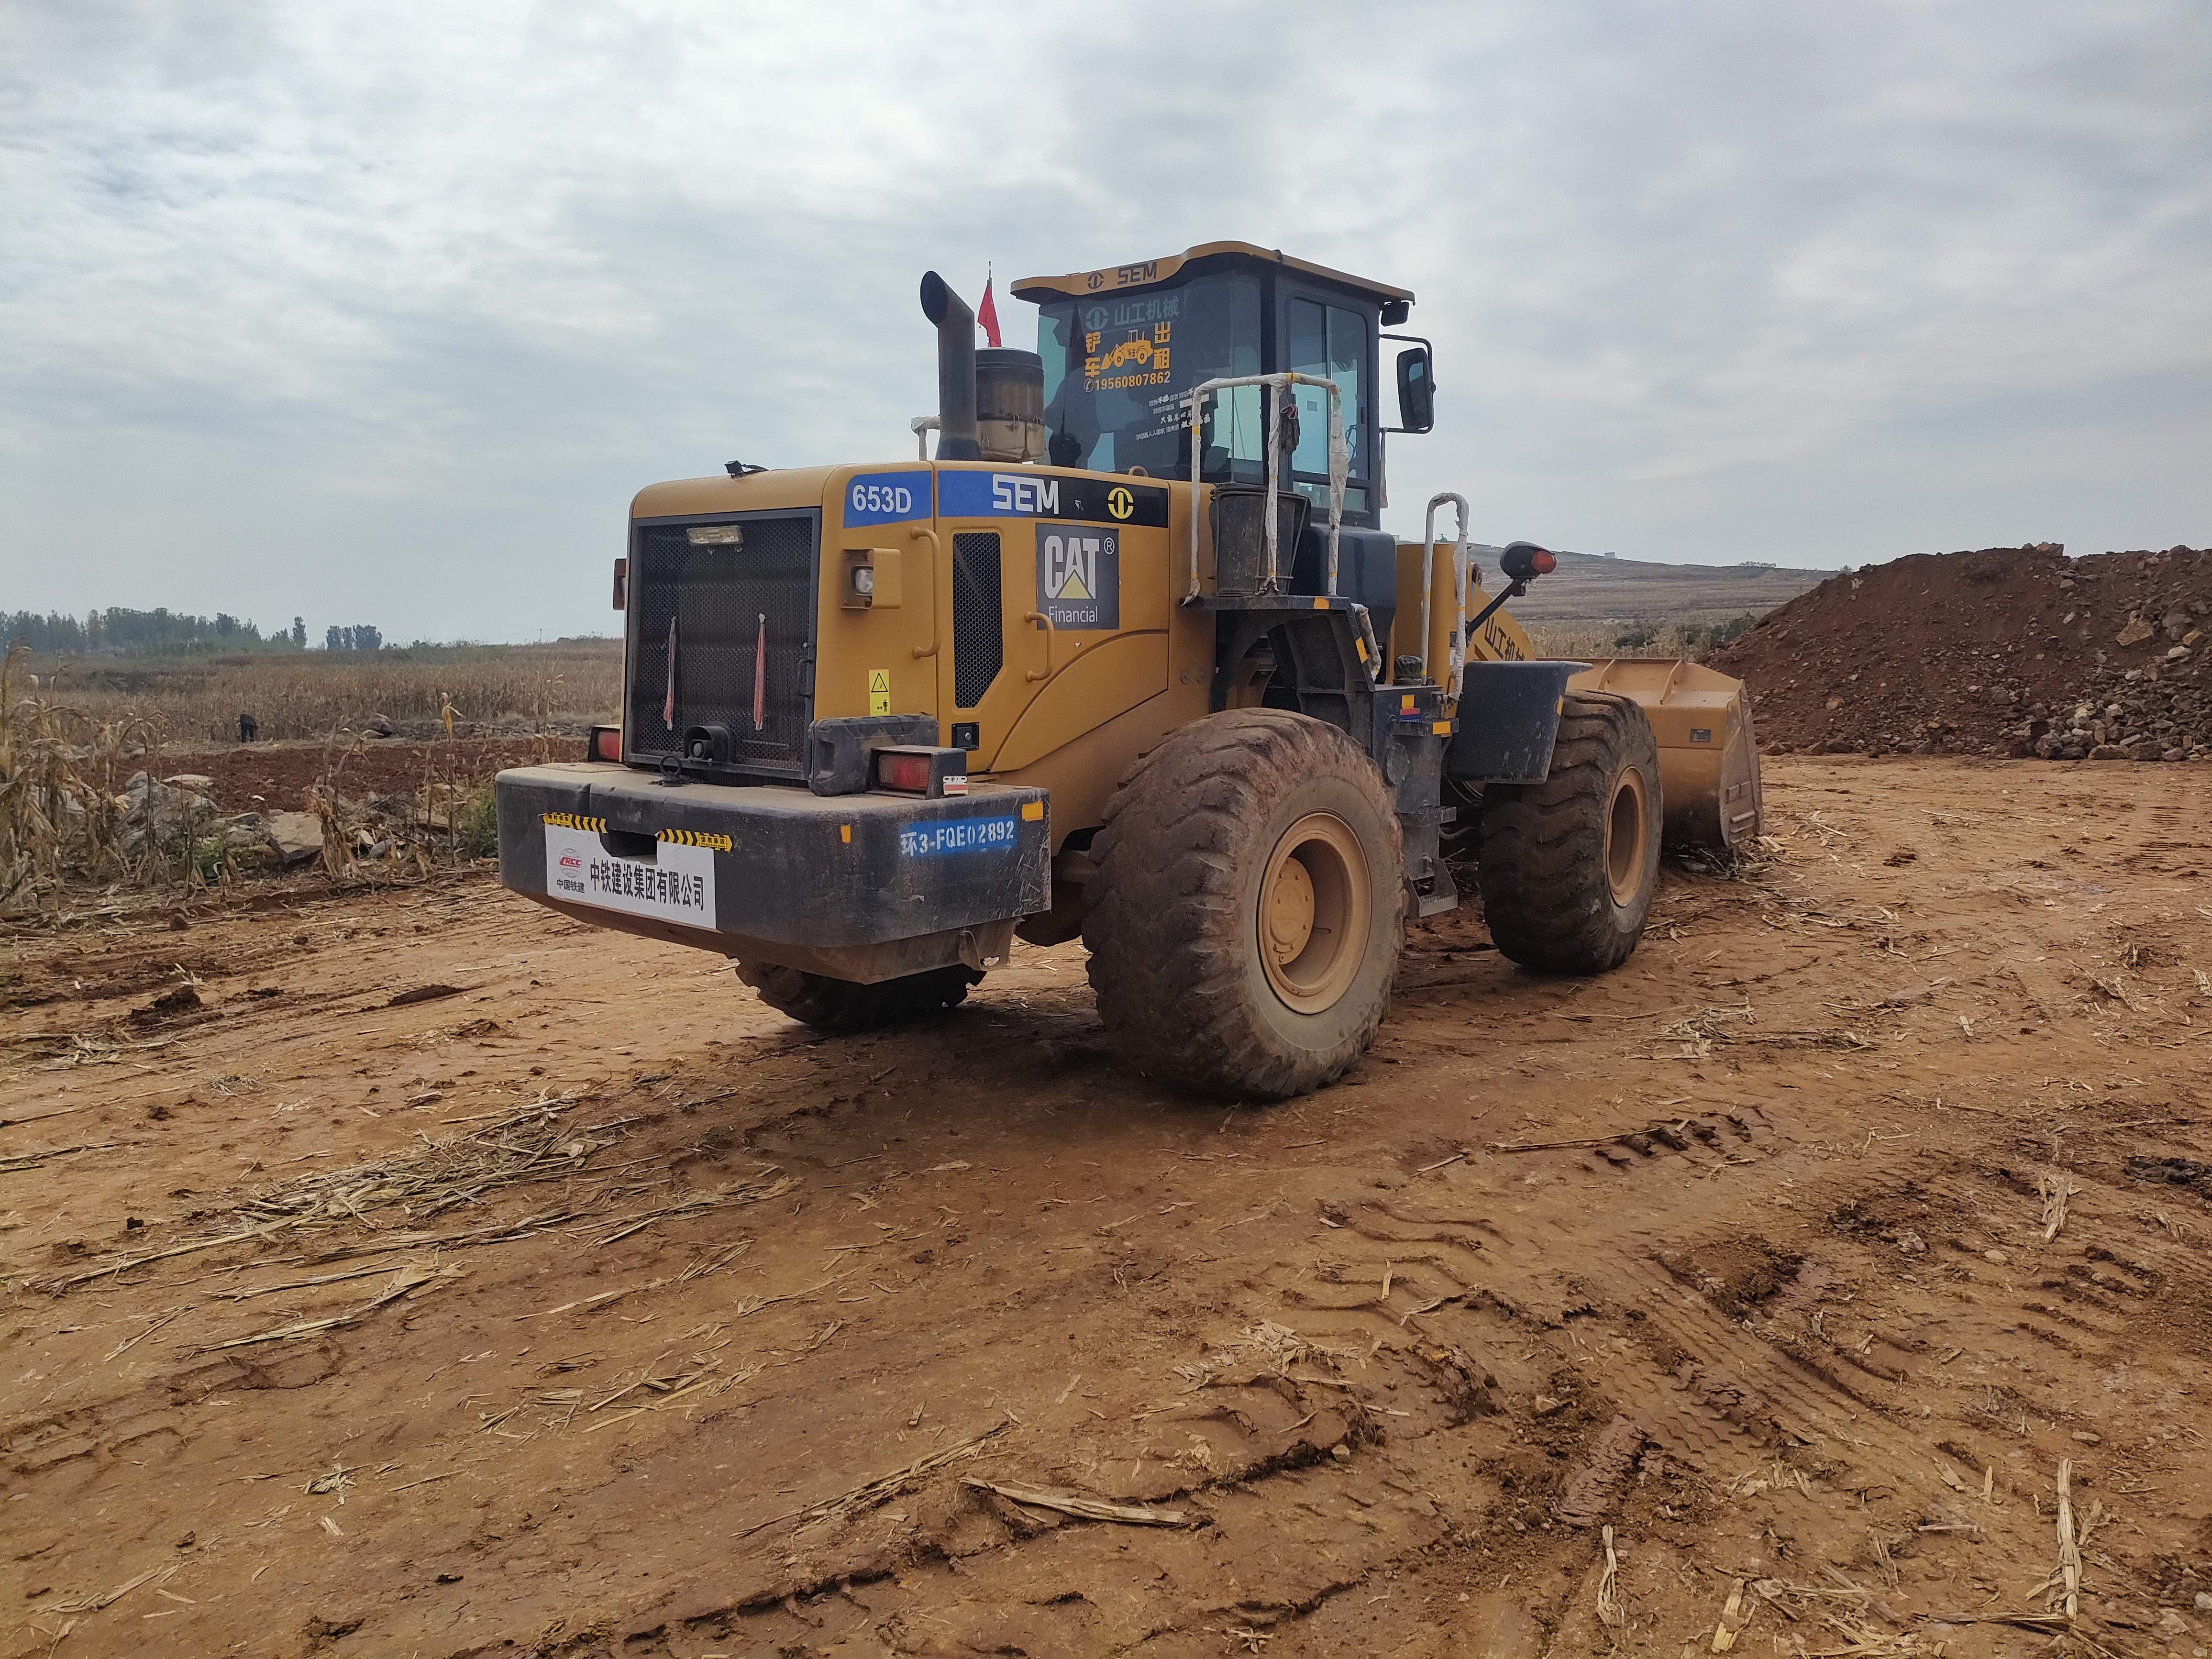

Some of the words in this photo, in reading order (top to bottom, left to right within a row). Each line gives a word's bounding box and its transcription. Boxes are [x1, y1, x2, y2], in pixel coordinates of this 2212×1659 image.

[1117, 262, 1157, 285] SEM
[1115, 296, 1180, 326] 山工机械
[1085, 332, 1101, 377] 铲车
[1153, 321, 1171, 370] 出租
[1095, 371, 1171, 391] 19560807862
[853, 485, 911, 513] 653D
[993, 474, 1059, 514] SEM
[1045, 535, 1100, 599] CAT
[1049, 606, 1098, 622] Financial
[556, 878, 585, 893] 中国铁建
[590, 858, 704, 911] 中铁建设集团有限公司
